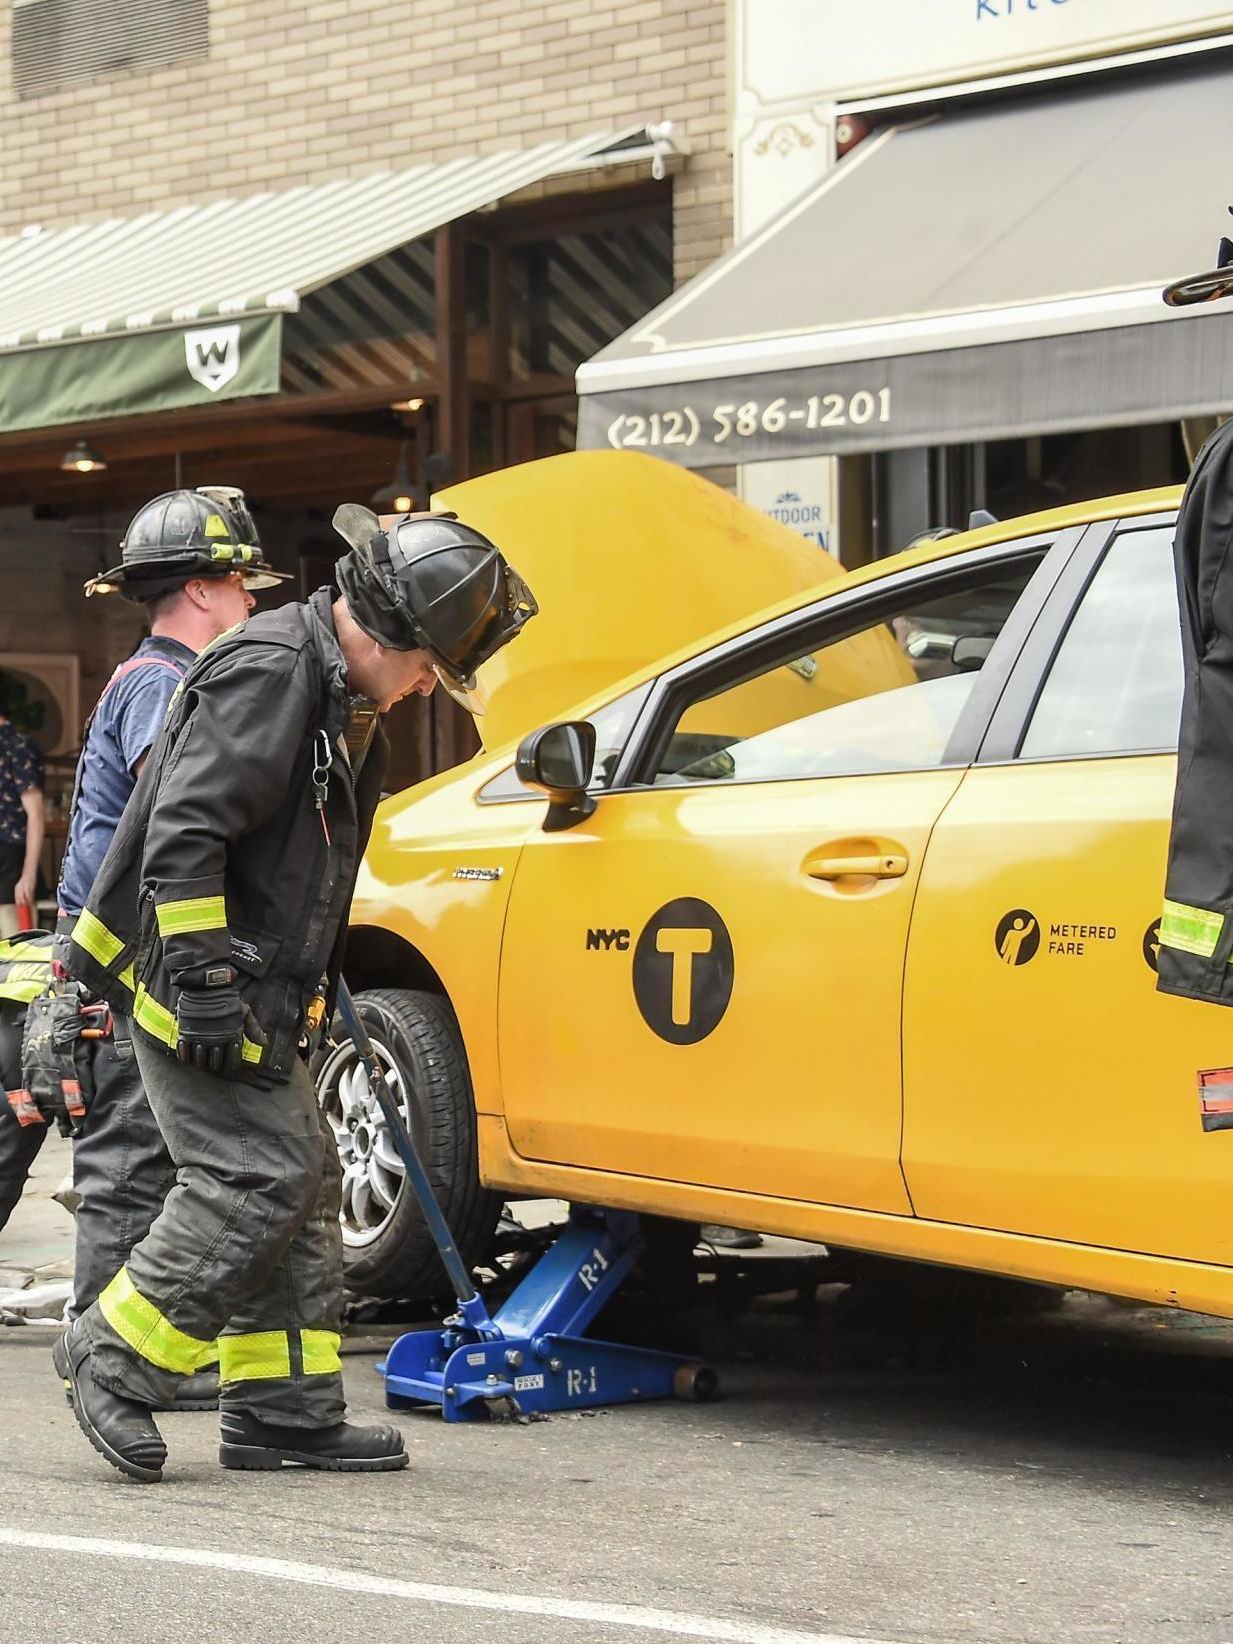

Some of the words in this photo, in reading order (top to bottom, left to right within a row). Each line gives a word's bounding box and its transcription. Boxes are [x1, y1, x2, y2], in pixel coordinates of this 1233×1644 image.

[195, 340, 229, 367] W
[607, 406, 701, 449] (212)
[713, 387, 891, 443] 586-1201
[764, 506, 821, 525] TDOOR
[1050, 924, 1116, 939] METERED
[1048, 942, 1084, 955] FARE
[585, 929, 630, 951] NYC
[656, 928, 712, 1025] T
